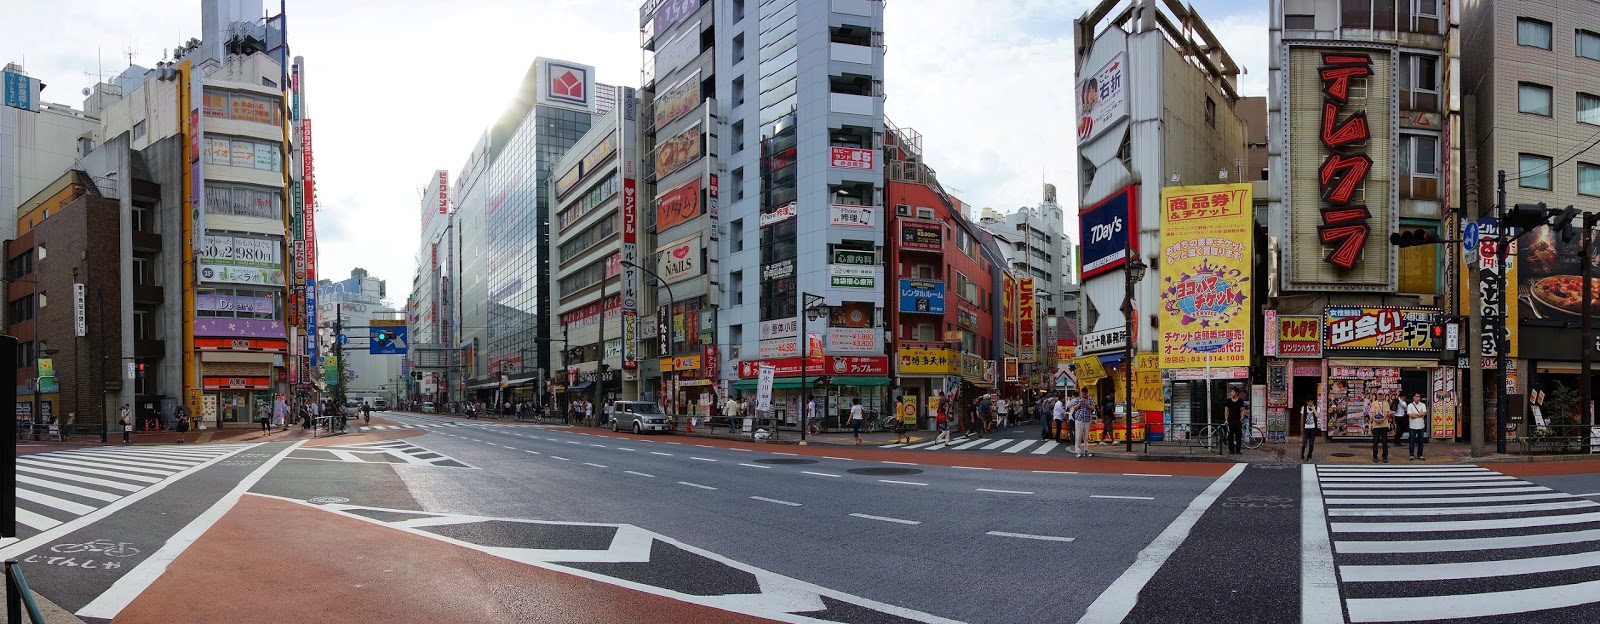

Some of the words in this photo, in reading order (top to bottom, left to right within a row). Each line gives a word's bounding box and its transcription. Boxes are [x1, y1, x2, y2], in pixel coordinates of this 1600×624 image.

[1099, 70, 1122, 100] 右折
[1317, 52, 1374, 272] テレクラ
[1169, 193, 1230, 212] 商品券
[625, 196, 635, 234] アイフル
[1090, 215, 1122, 245] 7Day's
[665, 258, 692, 277] NAILS
[837, 254, 873, 265] 心療内科
[901, 289, 944, 299] レンタルルーム
[1176, 275, 1219, 300] ヨコハマ
[1194, 287, 1236, 310] チケット
[1020, 279, 1034, 347] ビデオ鑑賞
[1281, 320, 1318, 338] テレクラ
[1331, 311, 1401, 345] 出会い
[1283, 343, 1316, 352] リンリンハウス
[1376, 331, 1403, 346] カフェ
[850, 364, 872, 373] アップル
[911, 355, 947, 366] 博多天神
[1143, 374, 1160, 384] 全品
[761, 375, 771, 408] 氷川神社
